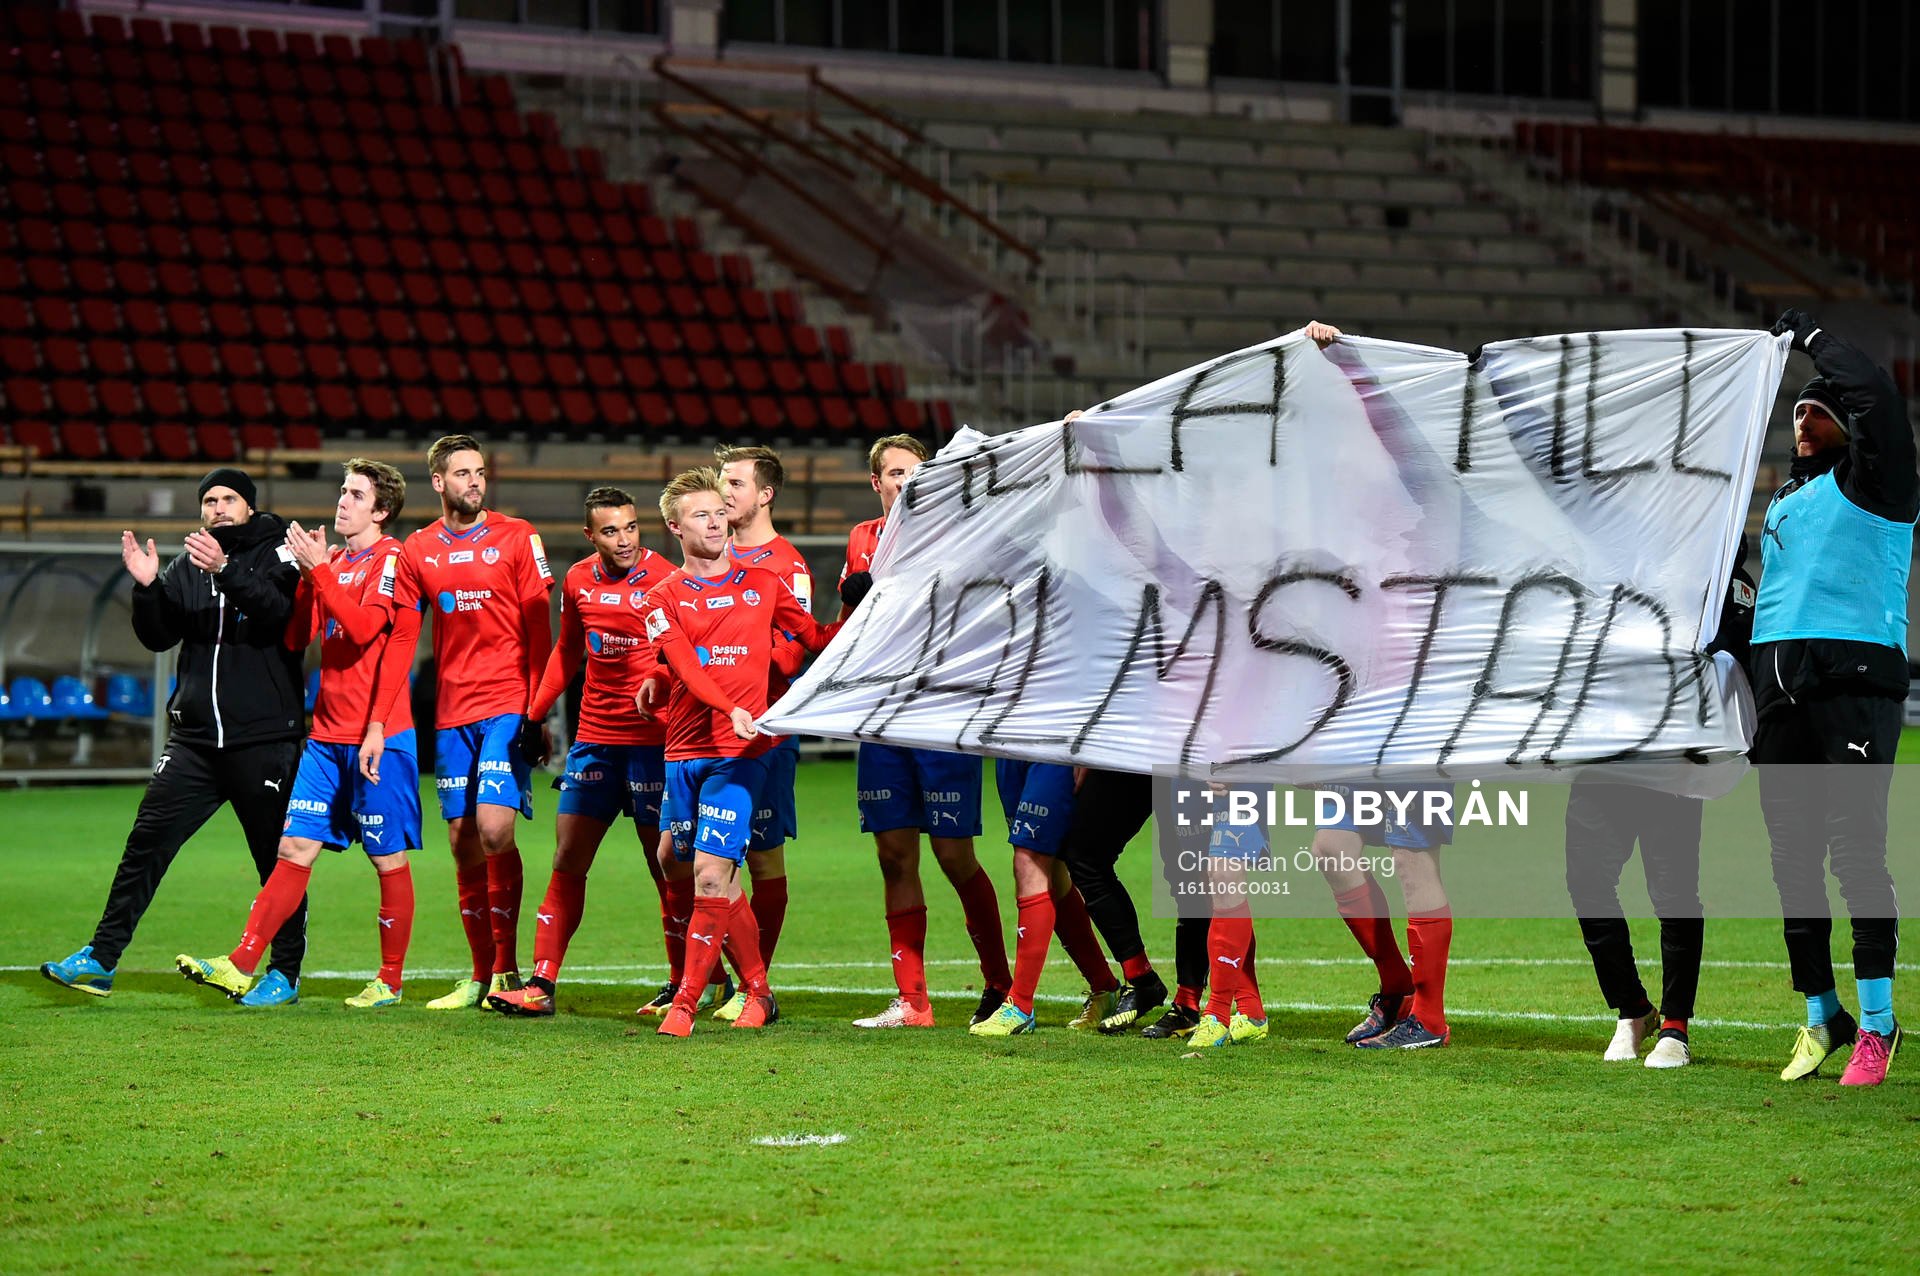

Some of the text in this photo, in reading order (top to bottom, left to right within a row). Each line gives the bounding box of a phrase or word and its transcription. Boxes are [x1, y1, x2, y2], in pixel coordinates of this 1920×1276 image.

[455, 589, 492, 600] Resurs
[457, 600, 483, 611] Bank
[602, 632, 639, 646] Resurs
[602, 644, 627, 655] Bank
[712, 644, 748, 655] Resurs
[480, 760, 512, 773] SOLID
[436, 777, 468, 789] SOLID
[630, 781, 663, 793] SOLID
[858, 789, 892, 801] SOLID
[926, 791, 961, 803] SOLID
[291, 799, 328, 813] SOLID
[701, 804, 737, 822] SOLID
[932, 810, 939, 827] 3
[1012, 819, 1022, 835] 5
[701, 826, 710, 842] 6
